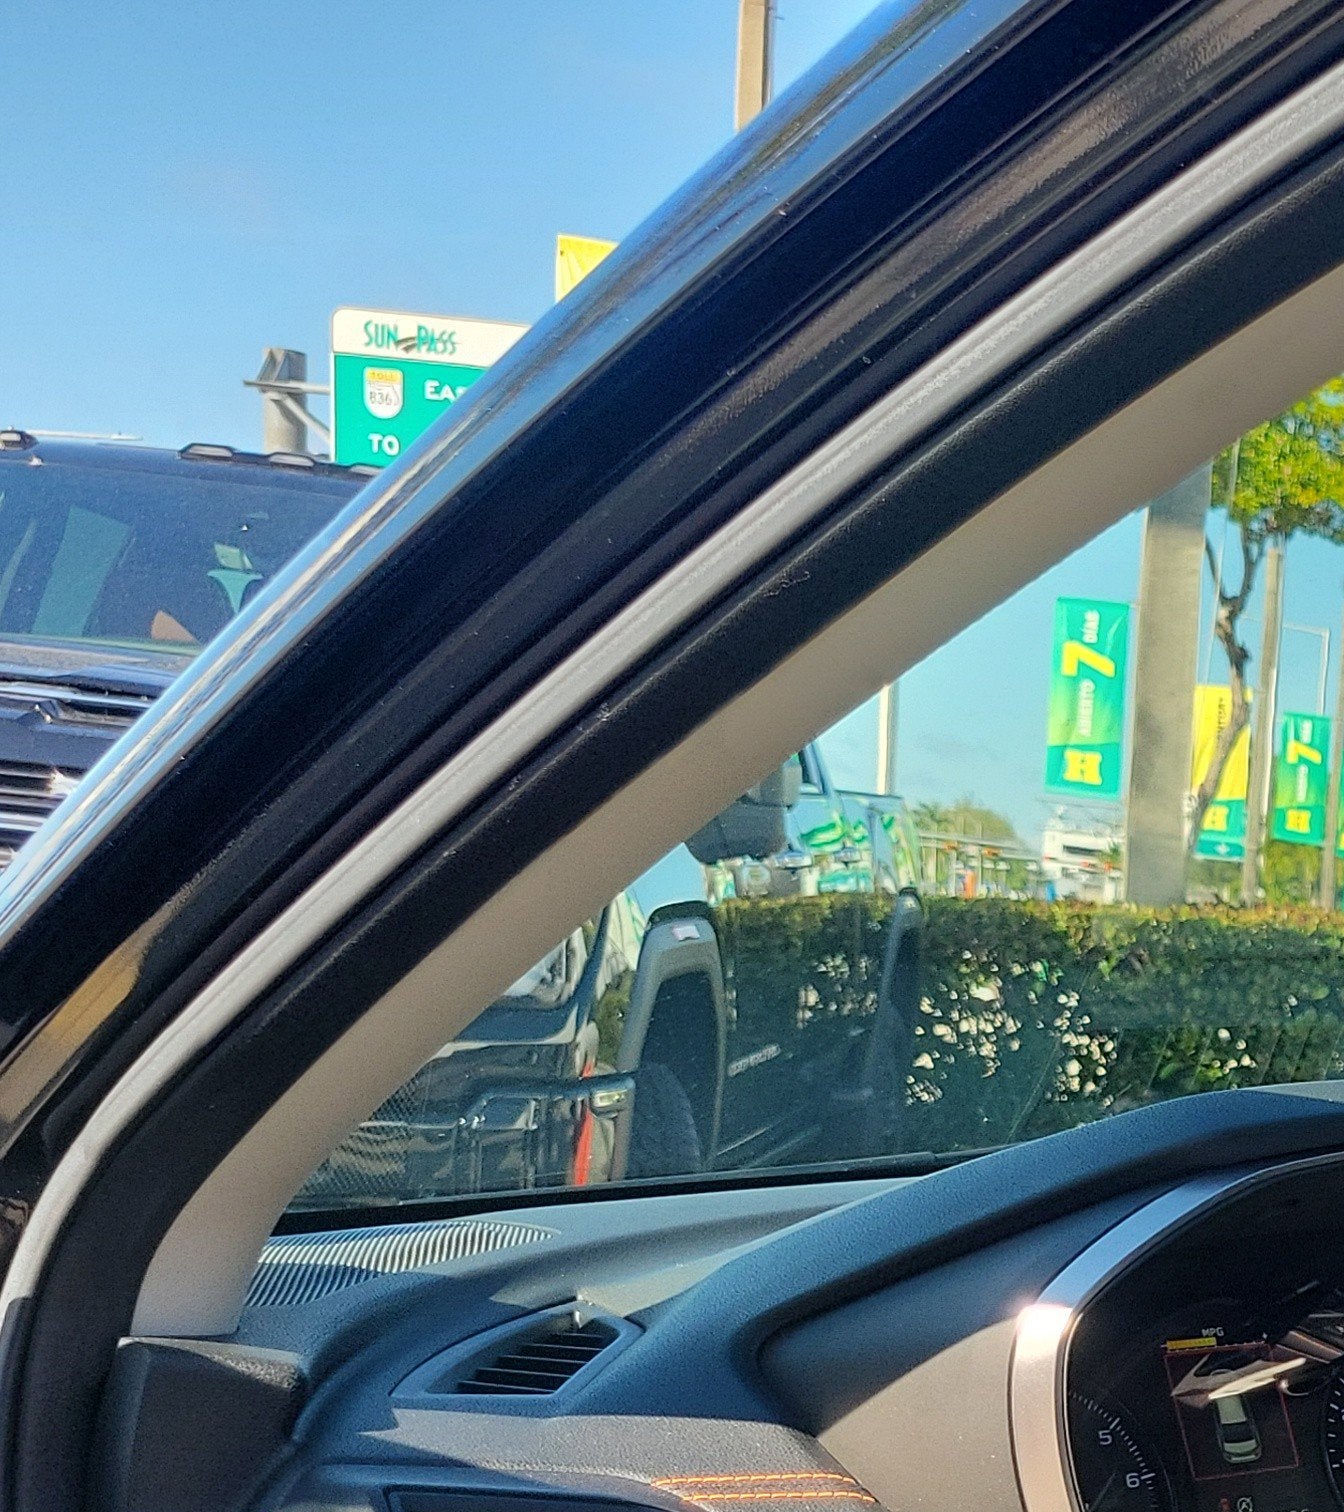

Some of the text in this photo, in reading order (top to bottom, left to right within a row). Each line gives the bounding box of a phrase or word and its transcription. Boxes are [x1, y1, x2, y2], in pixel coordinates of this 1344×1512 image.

[367, 432, 401, 457] TO
[1060, 639, 1116, 679] 7
[1286, 740, 1322, 765] 7
[1201, 1326, 1225, 1338] MPG
[1099, 1430, 1112, 1446] 5
[1126, 1472, 1140, 1489] 6
